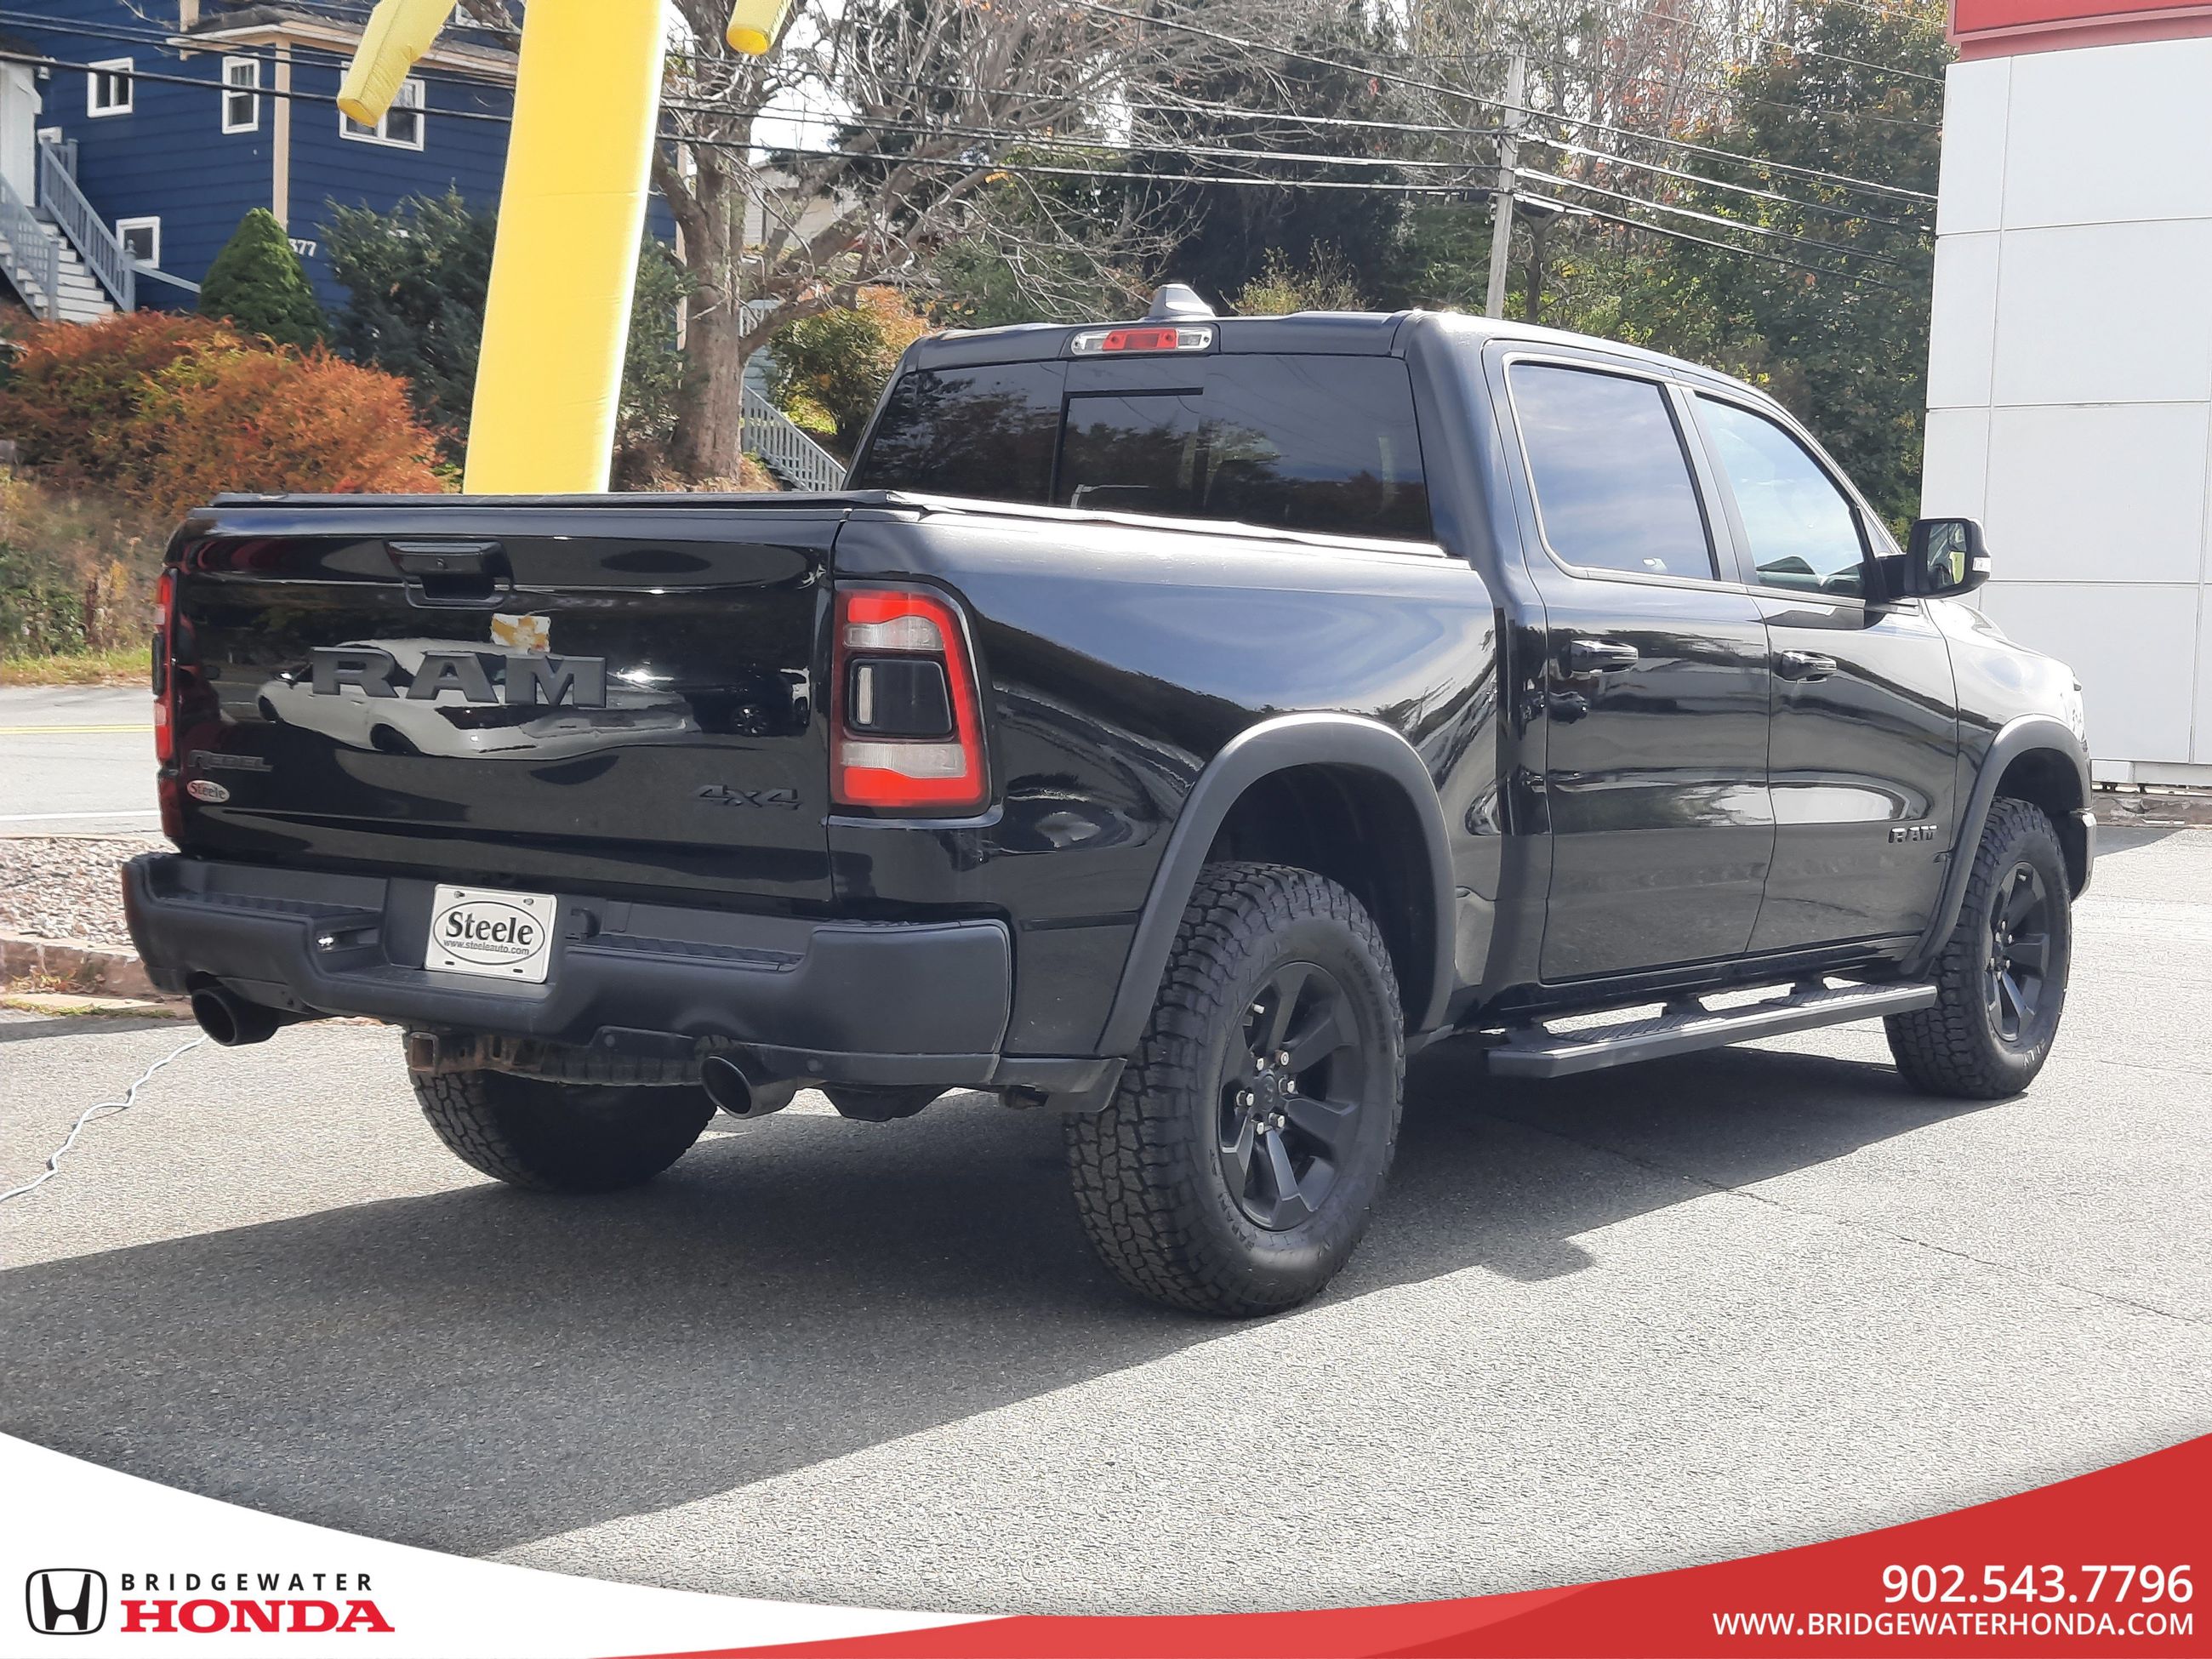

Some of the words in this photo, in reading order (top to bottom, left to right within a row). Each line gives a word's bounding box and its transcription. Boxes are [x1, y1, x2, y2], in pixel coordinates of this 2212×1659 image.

[311, 647, 607, 708] RAM
[188, 781, 226, 800] Steele
[1888, 824, 1937, 844] RAM
[445, 910, 533, 945] Steele
[443, 939, 530, 955] www.steeleauto.com
